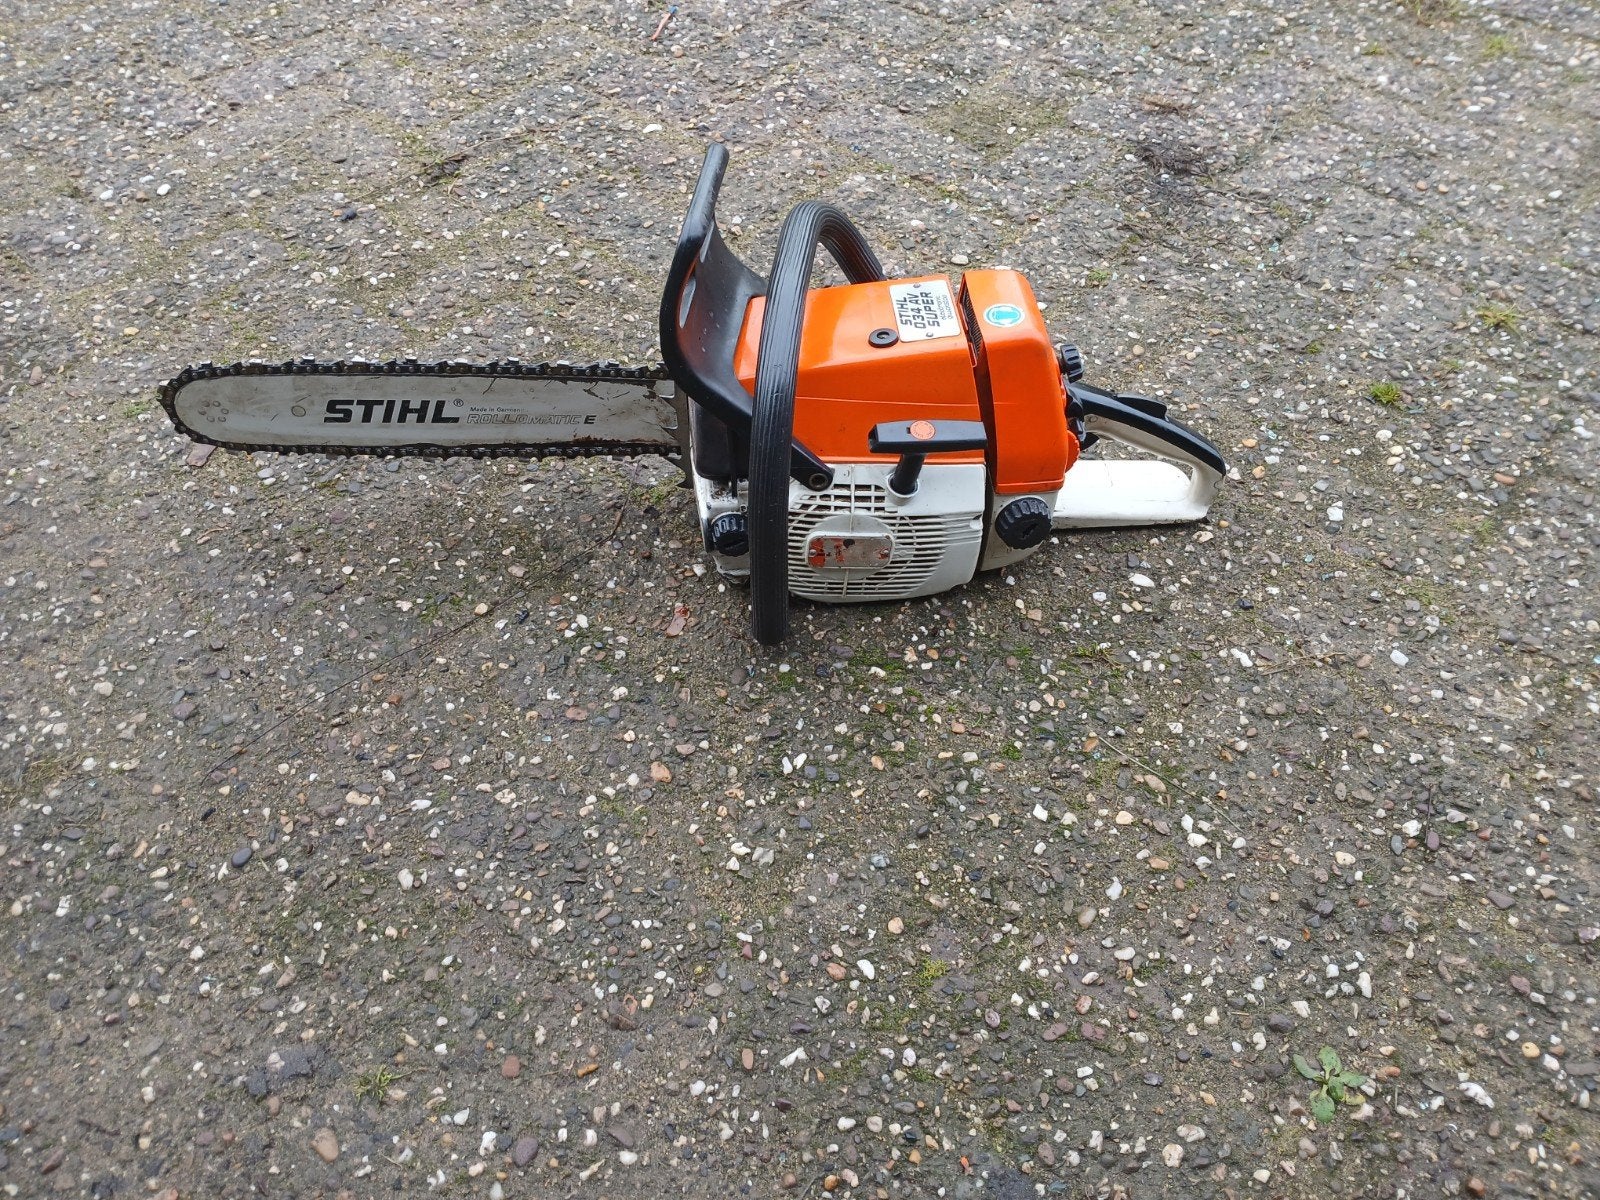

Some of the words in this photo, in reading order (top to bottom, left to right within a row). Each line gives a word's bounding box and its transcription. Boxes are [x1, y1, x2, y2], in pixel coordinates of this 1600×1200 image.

[907, 292, 921, 305] AV
[919, 291, 940, 327] SUPER
[895, 297, 912, 326] STIHL
[910, 307, 926, 329] 034
[323, 399, 460, 423] STIHL
[466, 413, 582, 425] ROLLOMATIC
[583, 414, 597, 425] E
